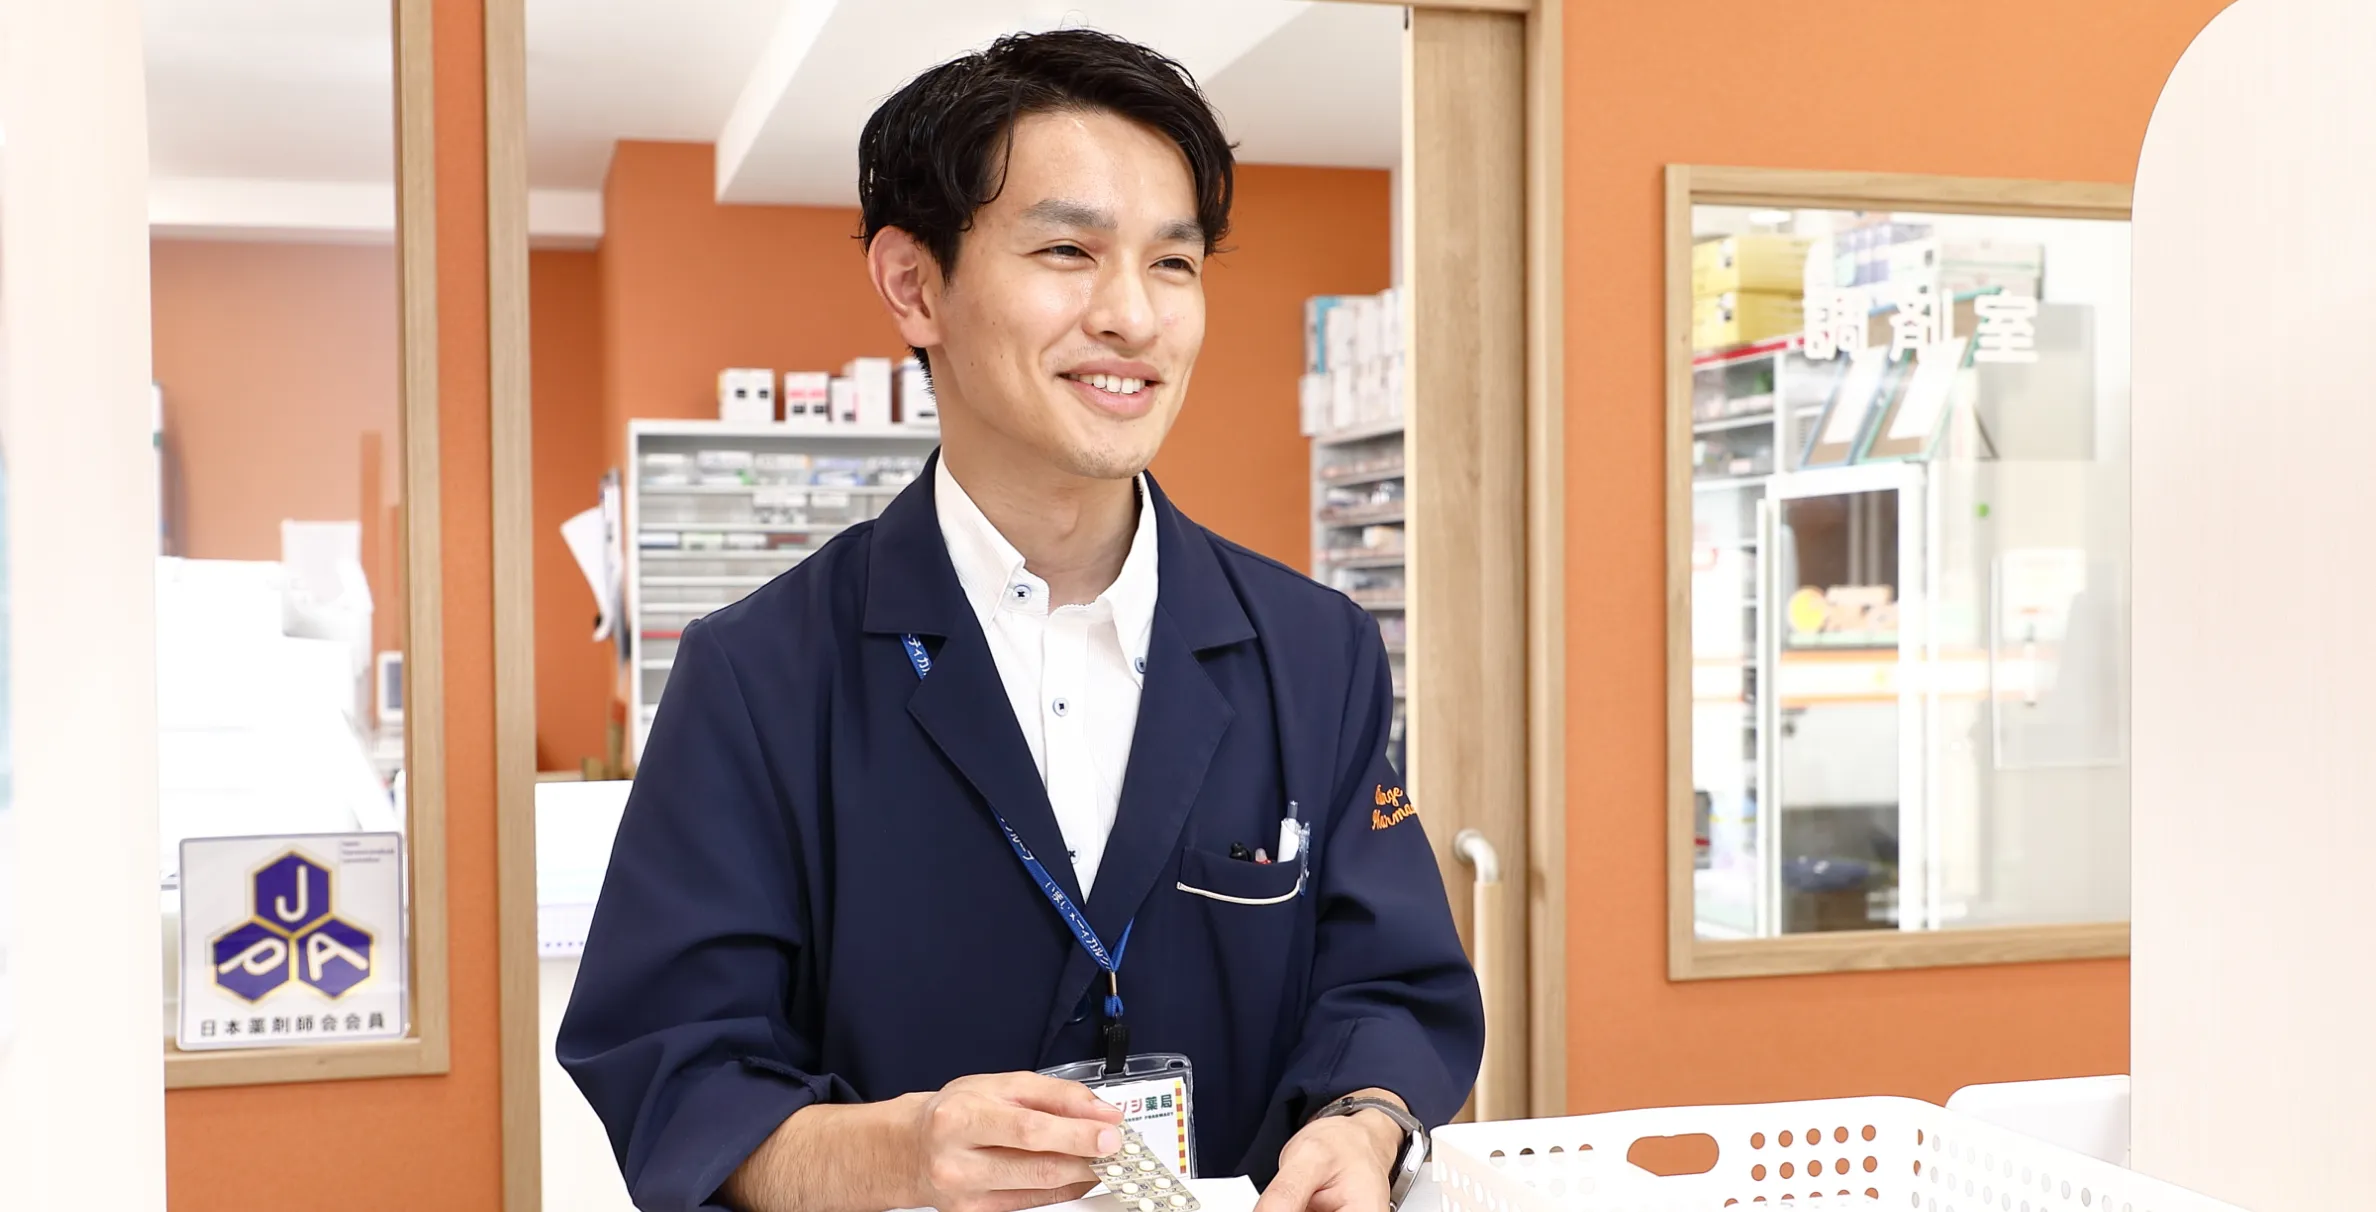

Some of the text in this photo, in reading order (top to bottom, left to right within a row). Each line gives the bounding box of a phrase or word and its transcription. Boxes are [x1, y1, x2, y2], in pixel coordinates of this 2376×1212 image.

[200, 1011, 385, 1038] 日本薬剤師会会員
